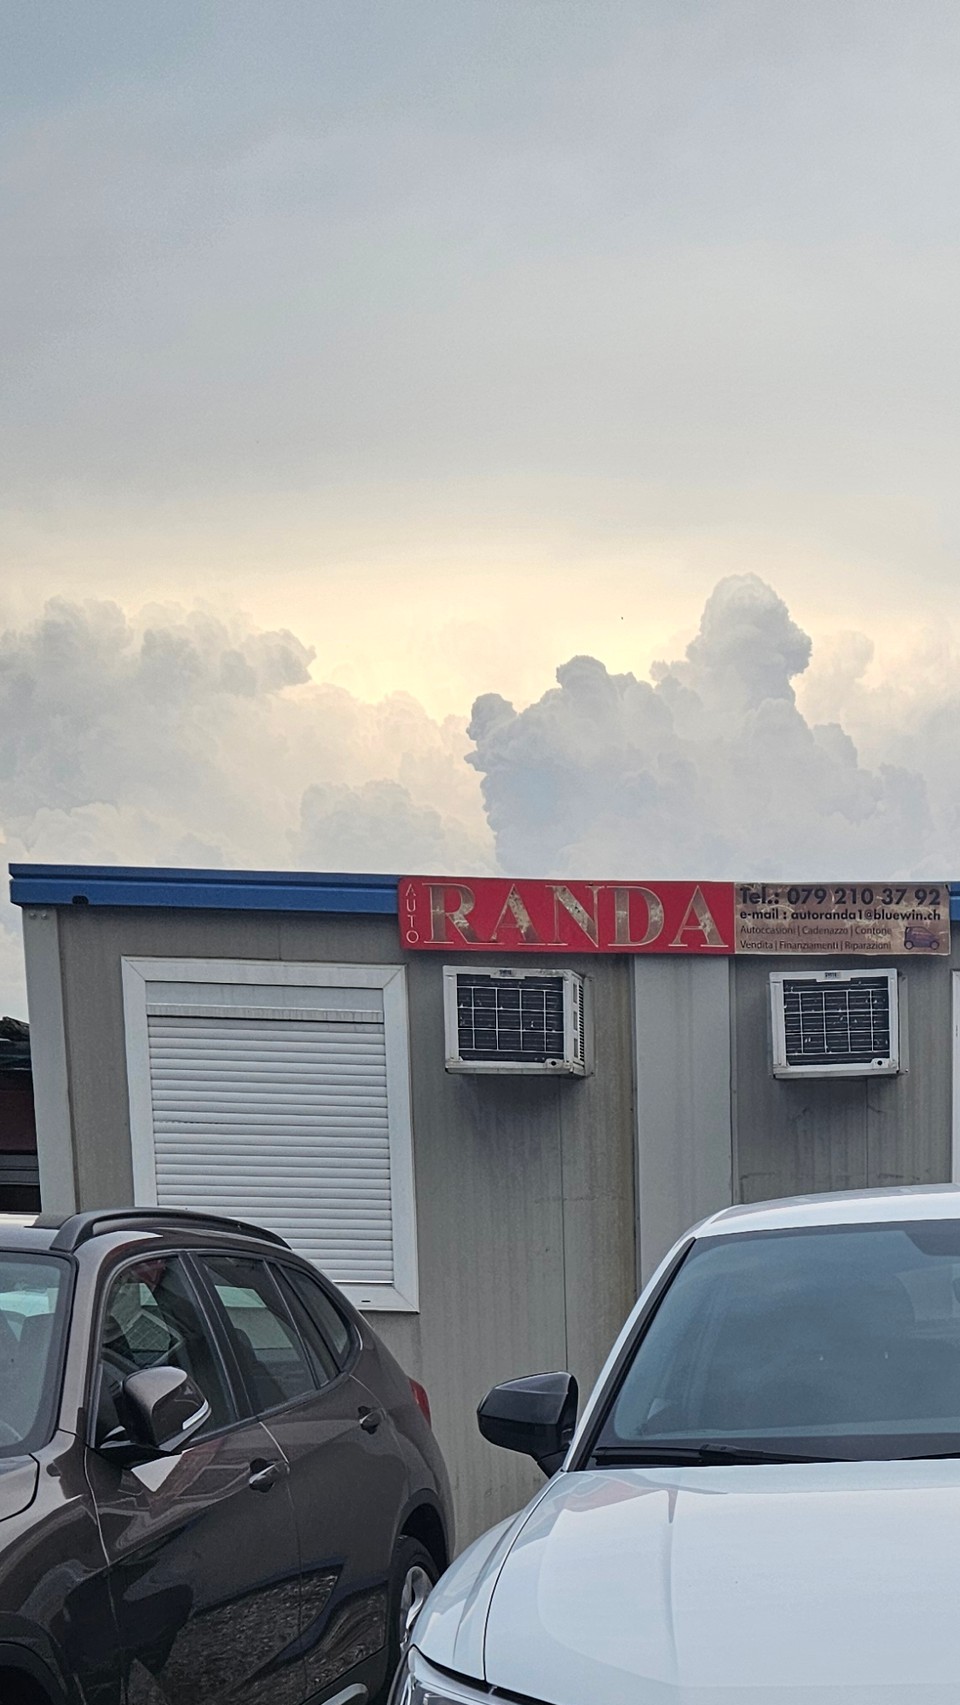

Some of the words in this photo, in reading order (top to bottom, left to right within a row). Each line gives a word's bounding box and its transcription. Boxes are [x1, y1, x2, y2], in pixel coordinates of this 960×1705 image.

[740, 886, 780, 905] Tel.:
[787, 887, 828, 906] 079
[834, 887, 874, 906] 210
[881, 887, 908, 906] 37
[914, 887, 941, 907] 92
[405, 883, 419, 944] AUTO
[421, 882, 729, 948] RANDA
[740, 908, 779, 920] e-mail
[791, 908, 941, 921] autoranda1@bluewin.ch
[740, 925, 796, 935] Autoccasioni
[802, 925, 849, 935] Cadenazzo
[854, 926, 892, 936] Contone
[740, 940, 773, 950] Vendita
[779, 940, 839, 950] Finanziamenti
[844, 941, 891, 951] Riparazioni
